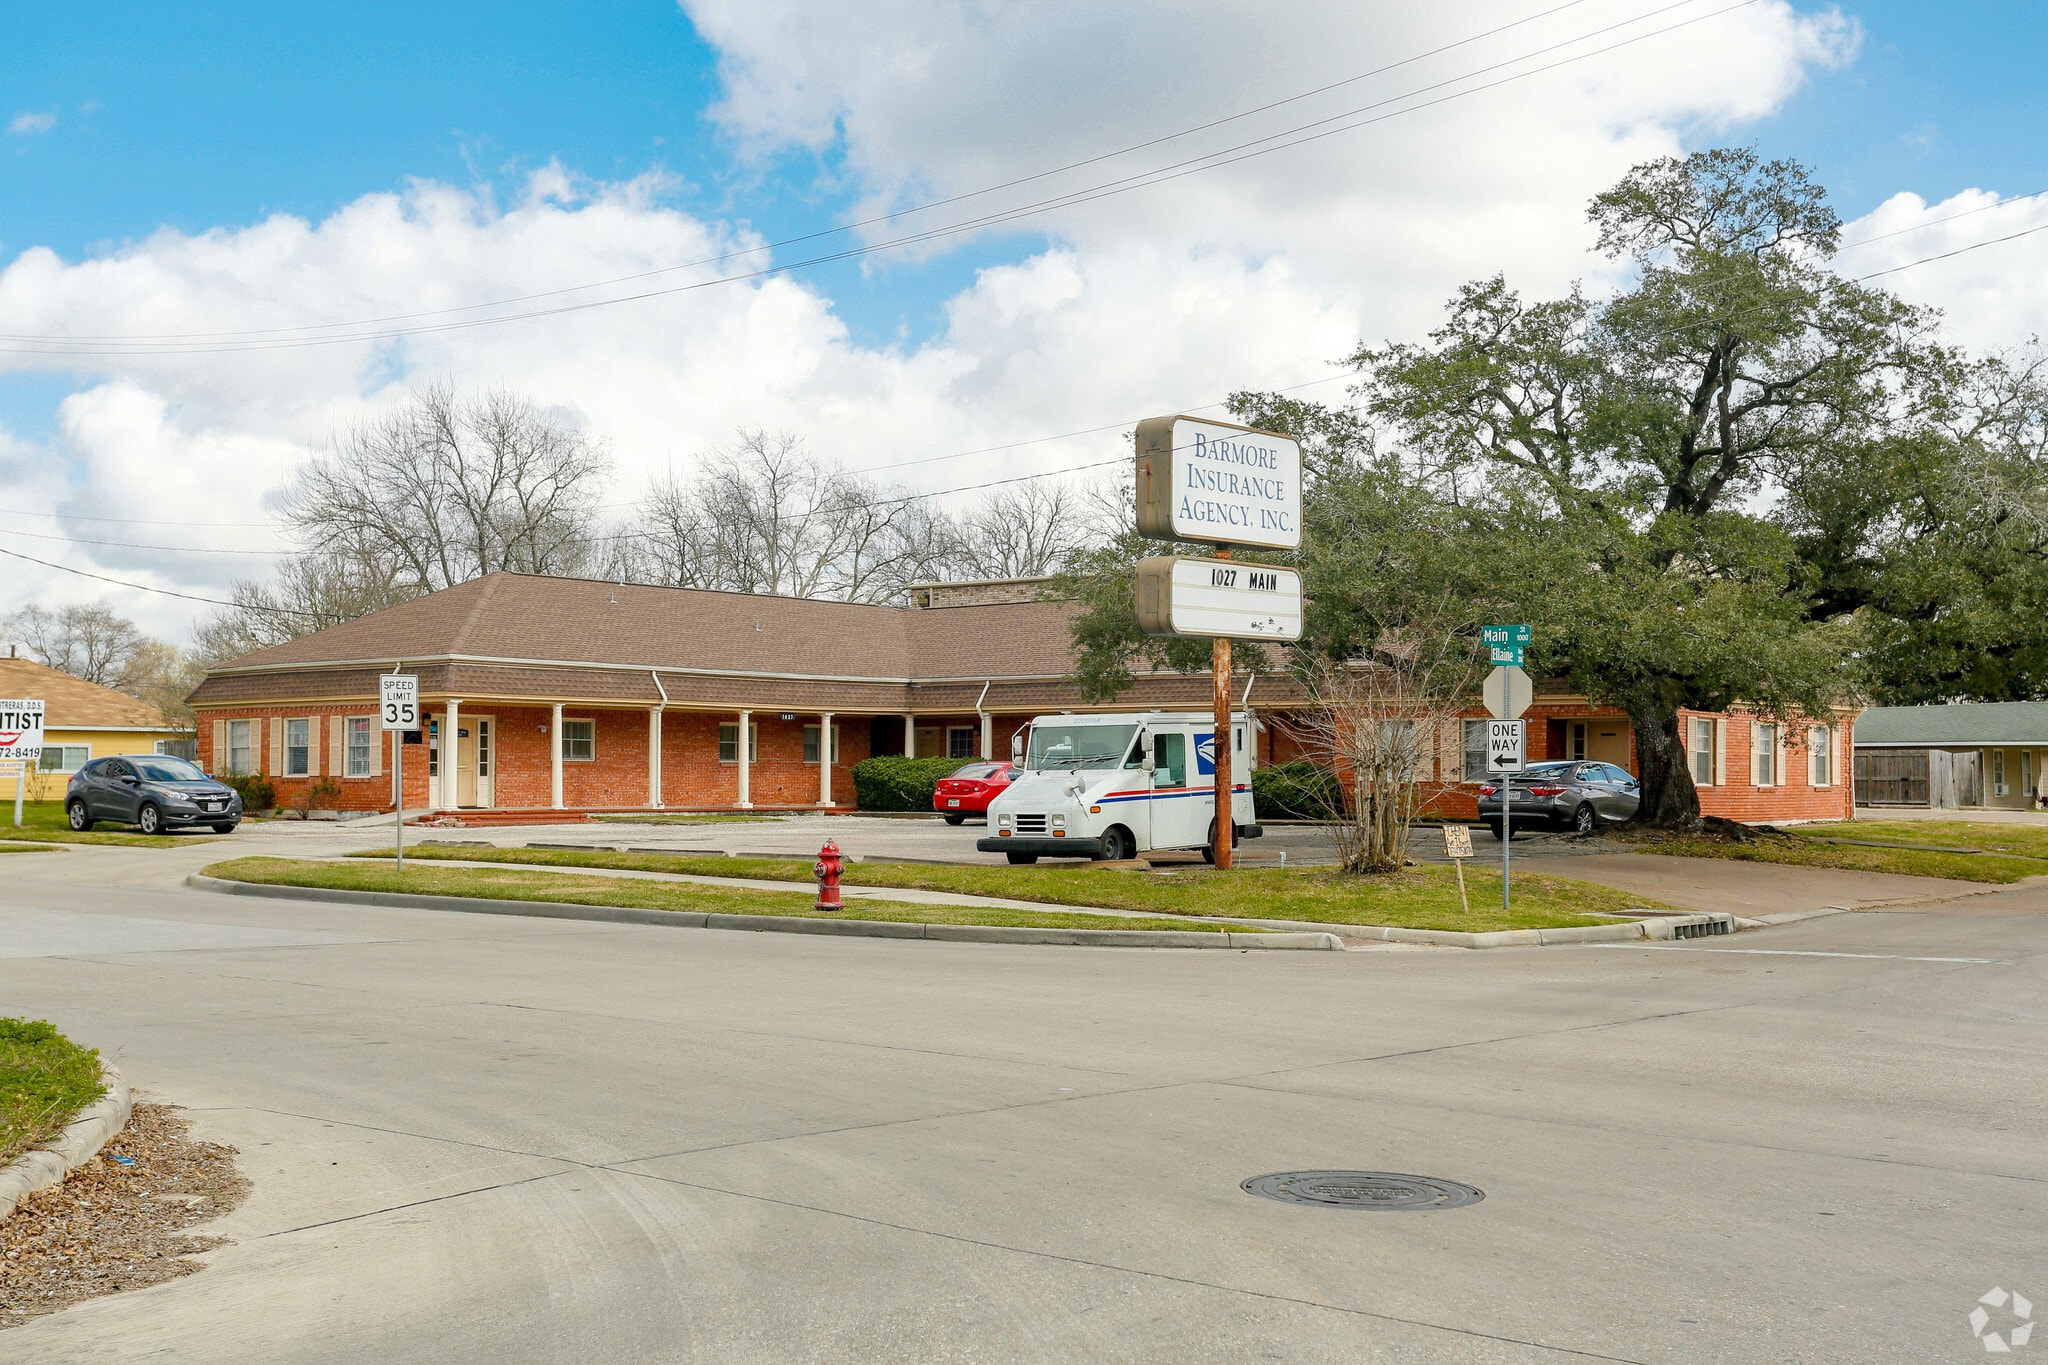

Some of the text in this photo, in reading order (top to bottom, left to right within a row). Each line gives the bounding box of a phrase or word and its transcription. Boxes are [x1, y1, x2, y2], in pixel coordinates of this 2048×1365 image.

[1195, 432, 1278, 469] BARMORE
[1187, 463, 1284, 500] INSURANCE
[1179, 494, 1294, 532] AGENCY, INC.
[1212, 568, 1277, 590] 1027 MAIN
[1484, 628, 1508, 642] Main
[383, 681, 414, 690] SPEED
[387, 692, 411, 701] LIMIT
[0, 701, 25, 711] TRERAS,
[385, 703, 414, 723] 35
[1492, 724, 1518, 737] ONE
[1491, 739, 1519, 751] WAY
